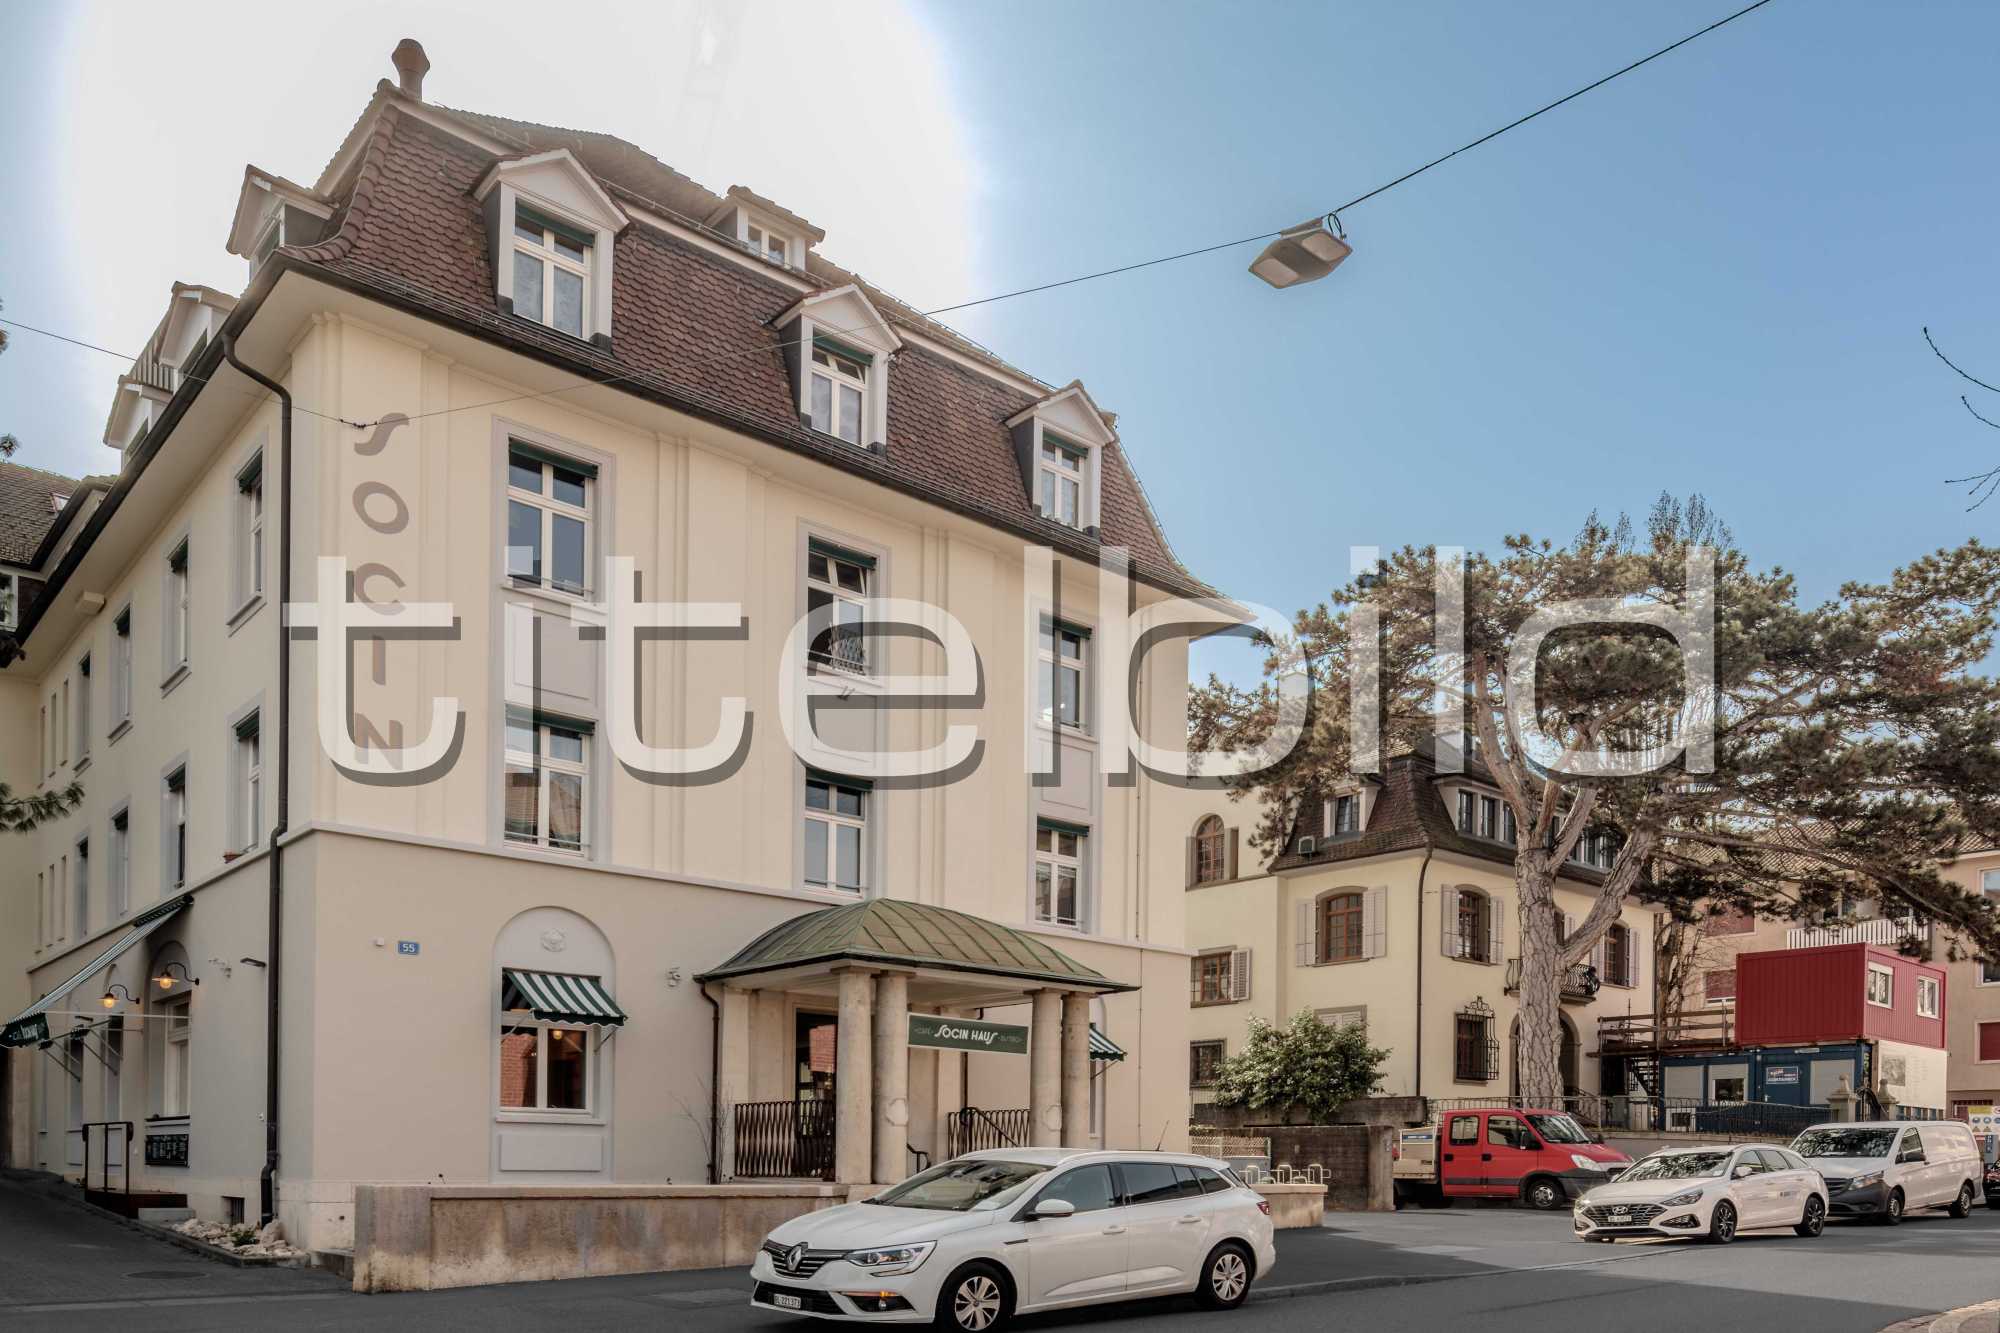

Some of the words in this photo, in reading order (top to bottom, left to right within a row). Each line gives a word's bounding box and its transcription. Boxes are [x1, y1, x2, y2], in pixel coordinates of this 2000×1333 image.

[352, 412, 409, 771] SOCIN
[402, 943, 415, 953] 55
[934, 1024, 969, 1039] SOCIN
[971, 1029, 998, 1045] HAUS
